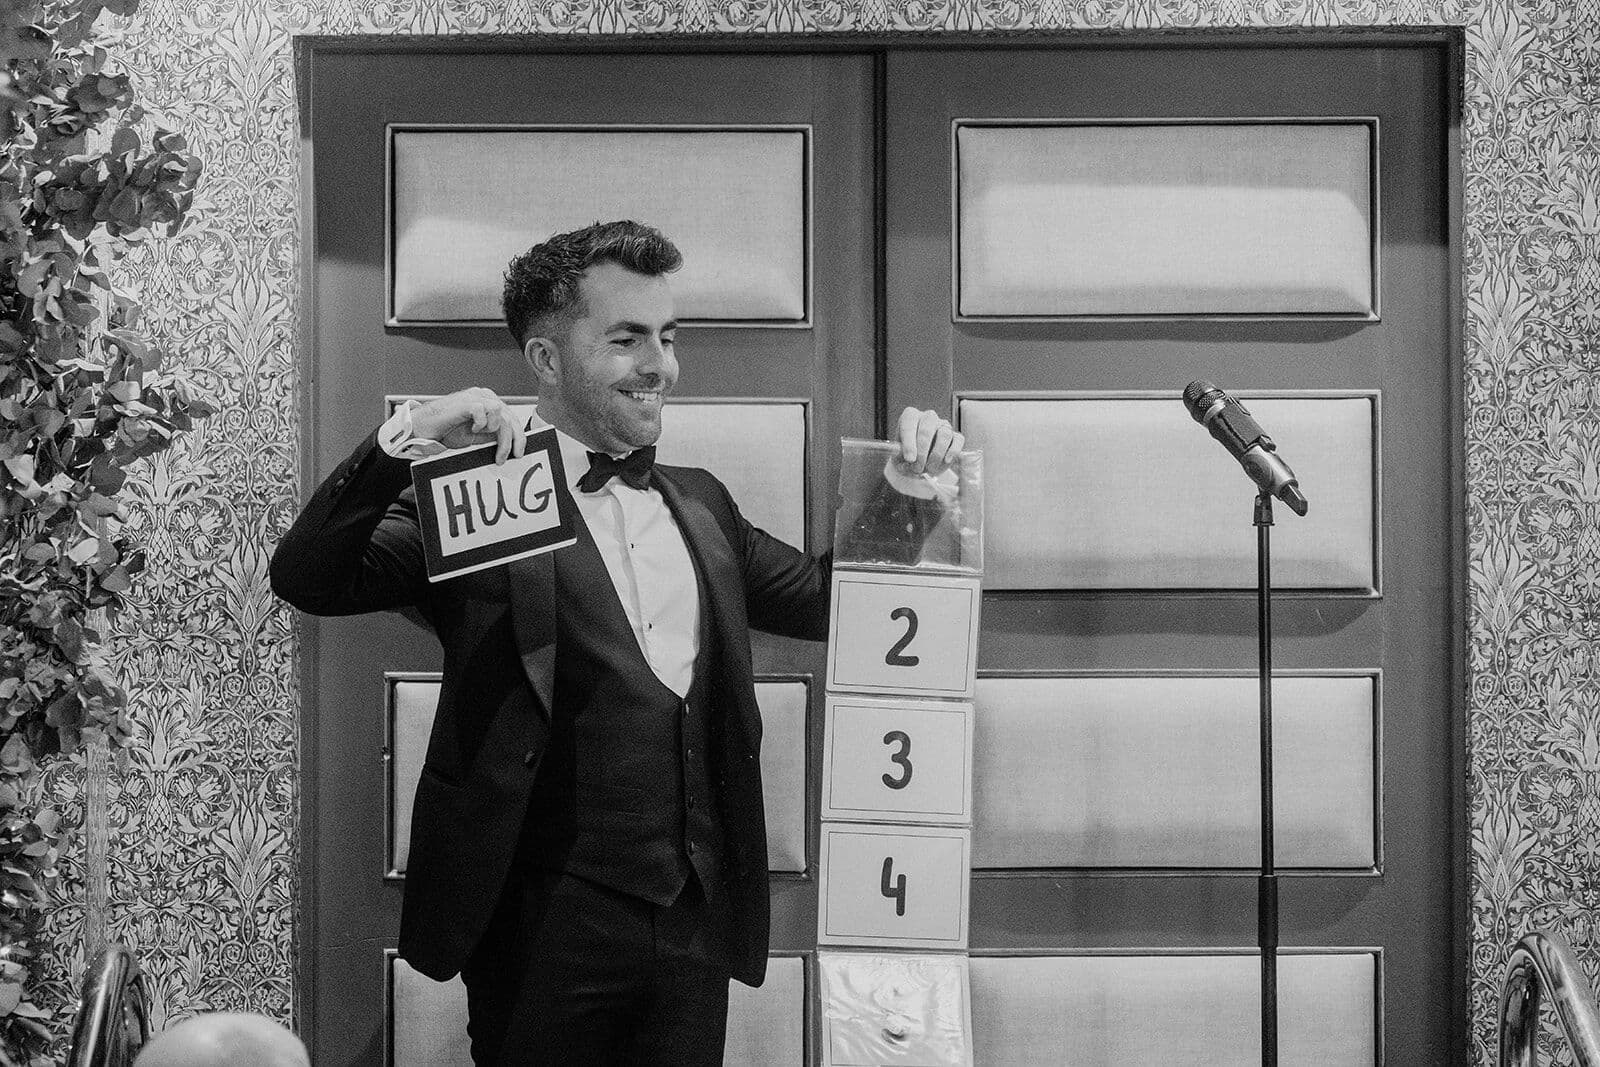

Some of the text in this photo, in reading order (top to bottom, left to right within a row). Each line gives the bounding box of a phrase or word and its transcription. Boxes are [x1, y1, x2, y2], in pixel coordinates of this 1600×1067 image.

[443, 463, 553, 538] HUG
[885, 607, 920, 667] 2
[882, 730, 913, 790] 3
[881, 857, 907, 917] 4
